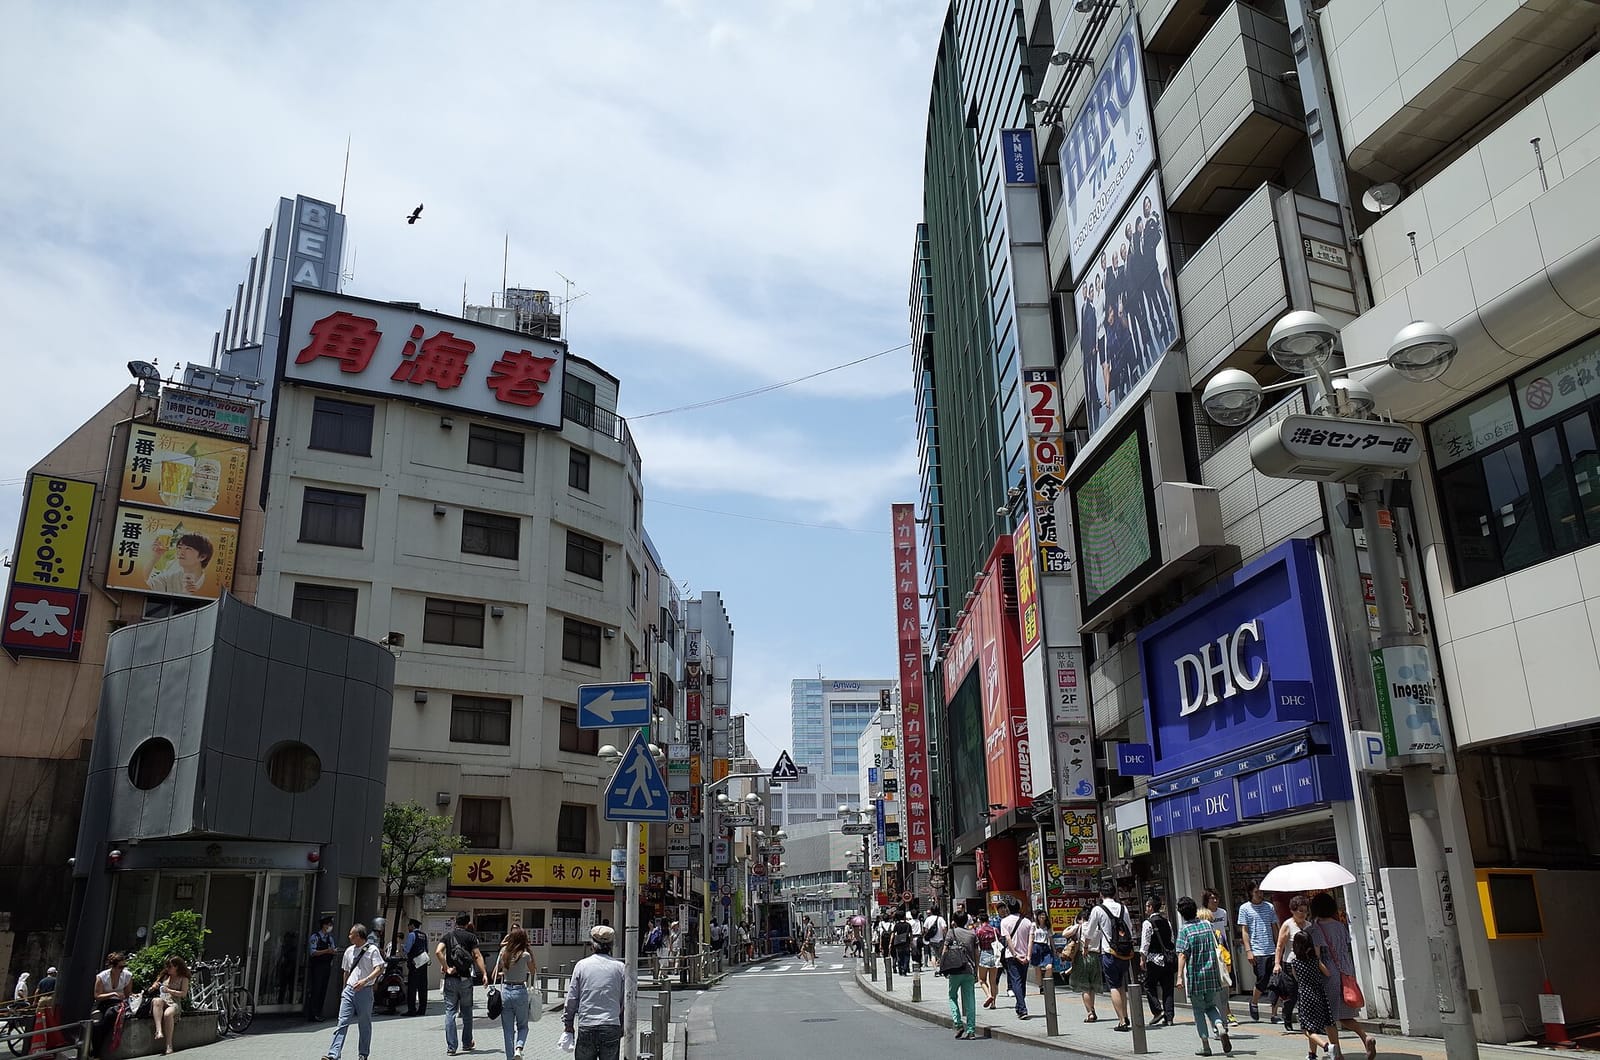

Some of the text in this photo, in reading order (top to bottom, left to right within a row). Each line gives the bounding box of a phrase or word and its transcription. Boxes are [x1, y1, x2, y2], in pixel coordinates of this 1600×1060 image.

[1062, 32, 1137, 206] HERO
[294, 310, 557, 407] 角海老
[1032, 371, 1048, 382] B1
[1290, 427, 1414, 454] 渋谷センター街
[131, 429, 156, 490] 一番搾り
[118, 512, 144, 576] 一番搾り
[10, 599, 70, 638] 本
[1174, 619, 1264, 717] DHC
[832, 681, 860, 690] Amway
[1061, 694, 1077, 705] 2F
[1281, 695, 1306, 706] DHC
[1124, 754, 1145, 764] DHC
[1366, 737, 1383, 764] P
[1063, 811, 1097, 825] まんが
[1205, 793, 1230, 816] DHC
[911, 802, 927, 855] 歌広場
[467, 858, 534, 883] 兆楽
